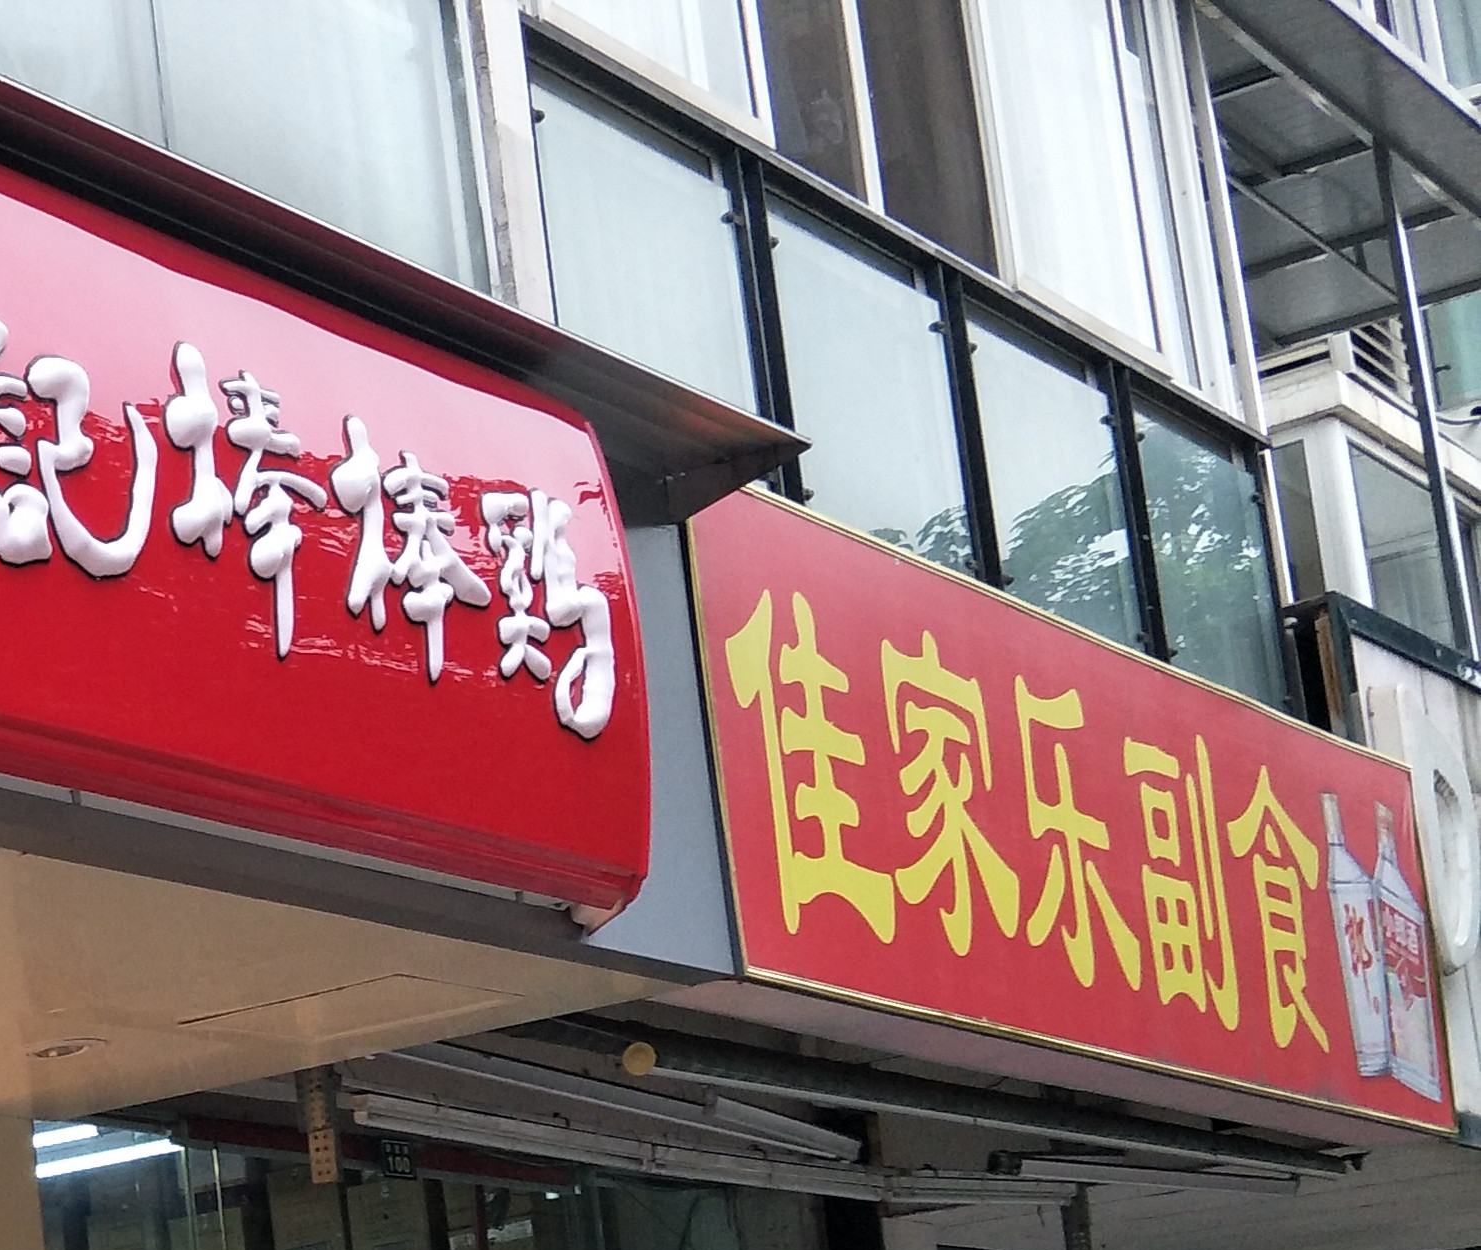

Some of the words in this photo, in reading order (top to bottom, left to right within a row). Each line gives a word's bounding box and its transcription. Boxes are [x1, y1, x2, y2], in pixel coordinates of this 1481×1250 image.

[724, 589, 1329, 1053] 佳家乐副食
